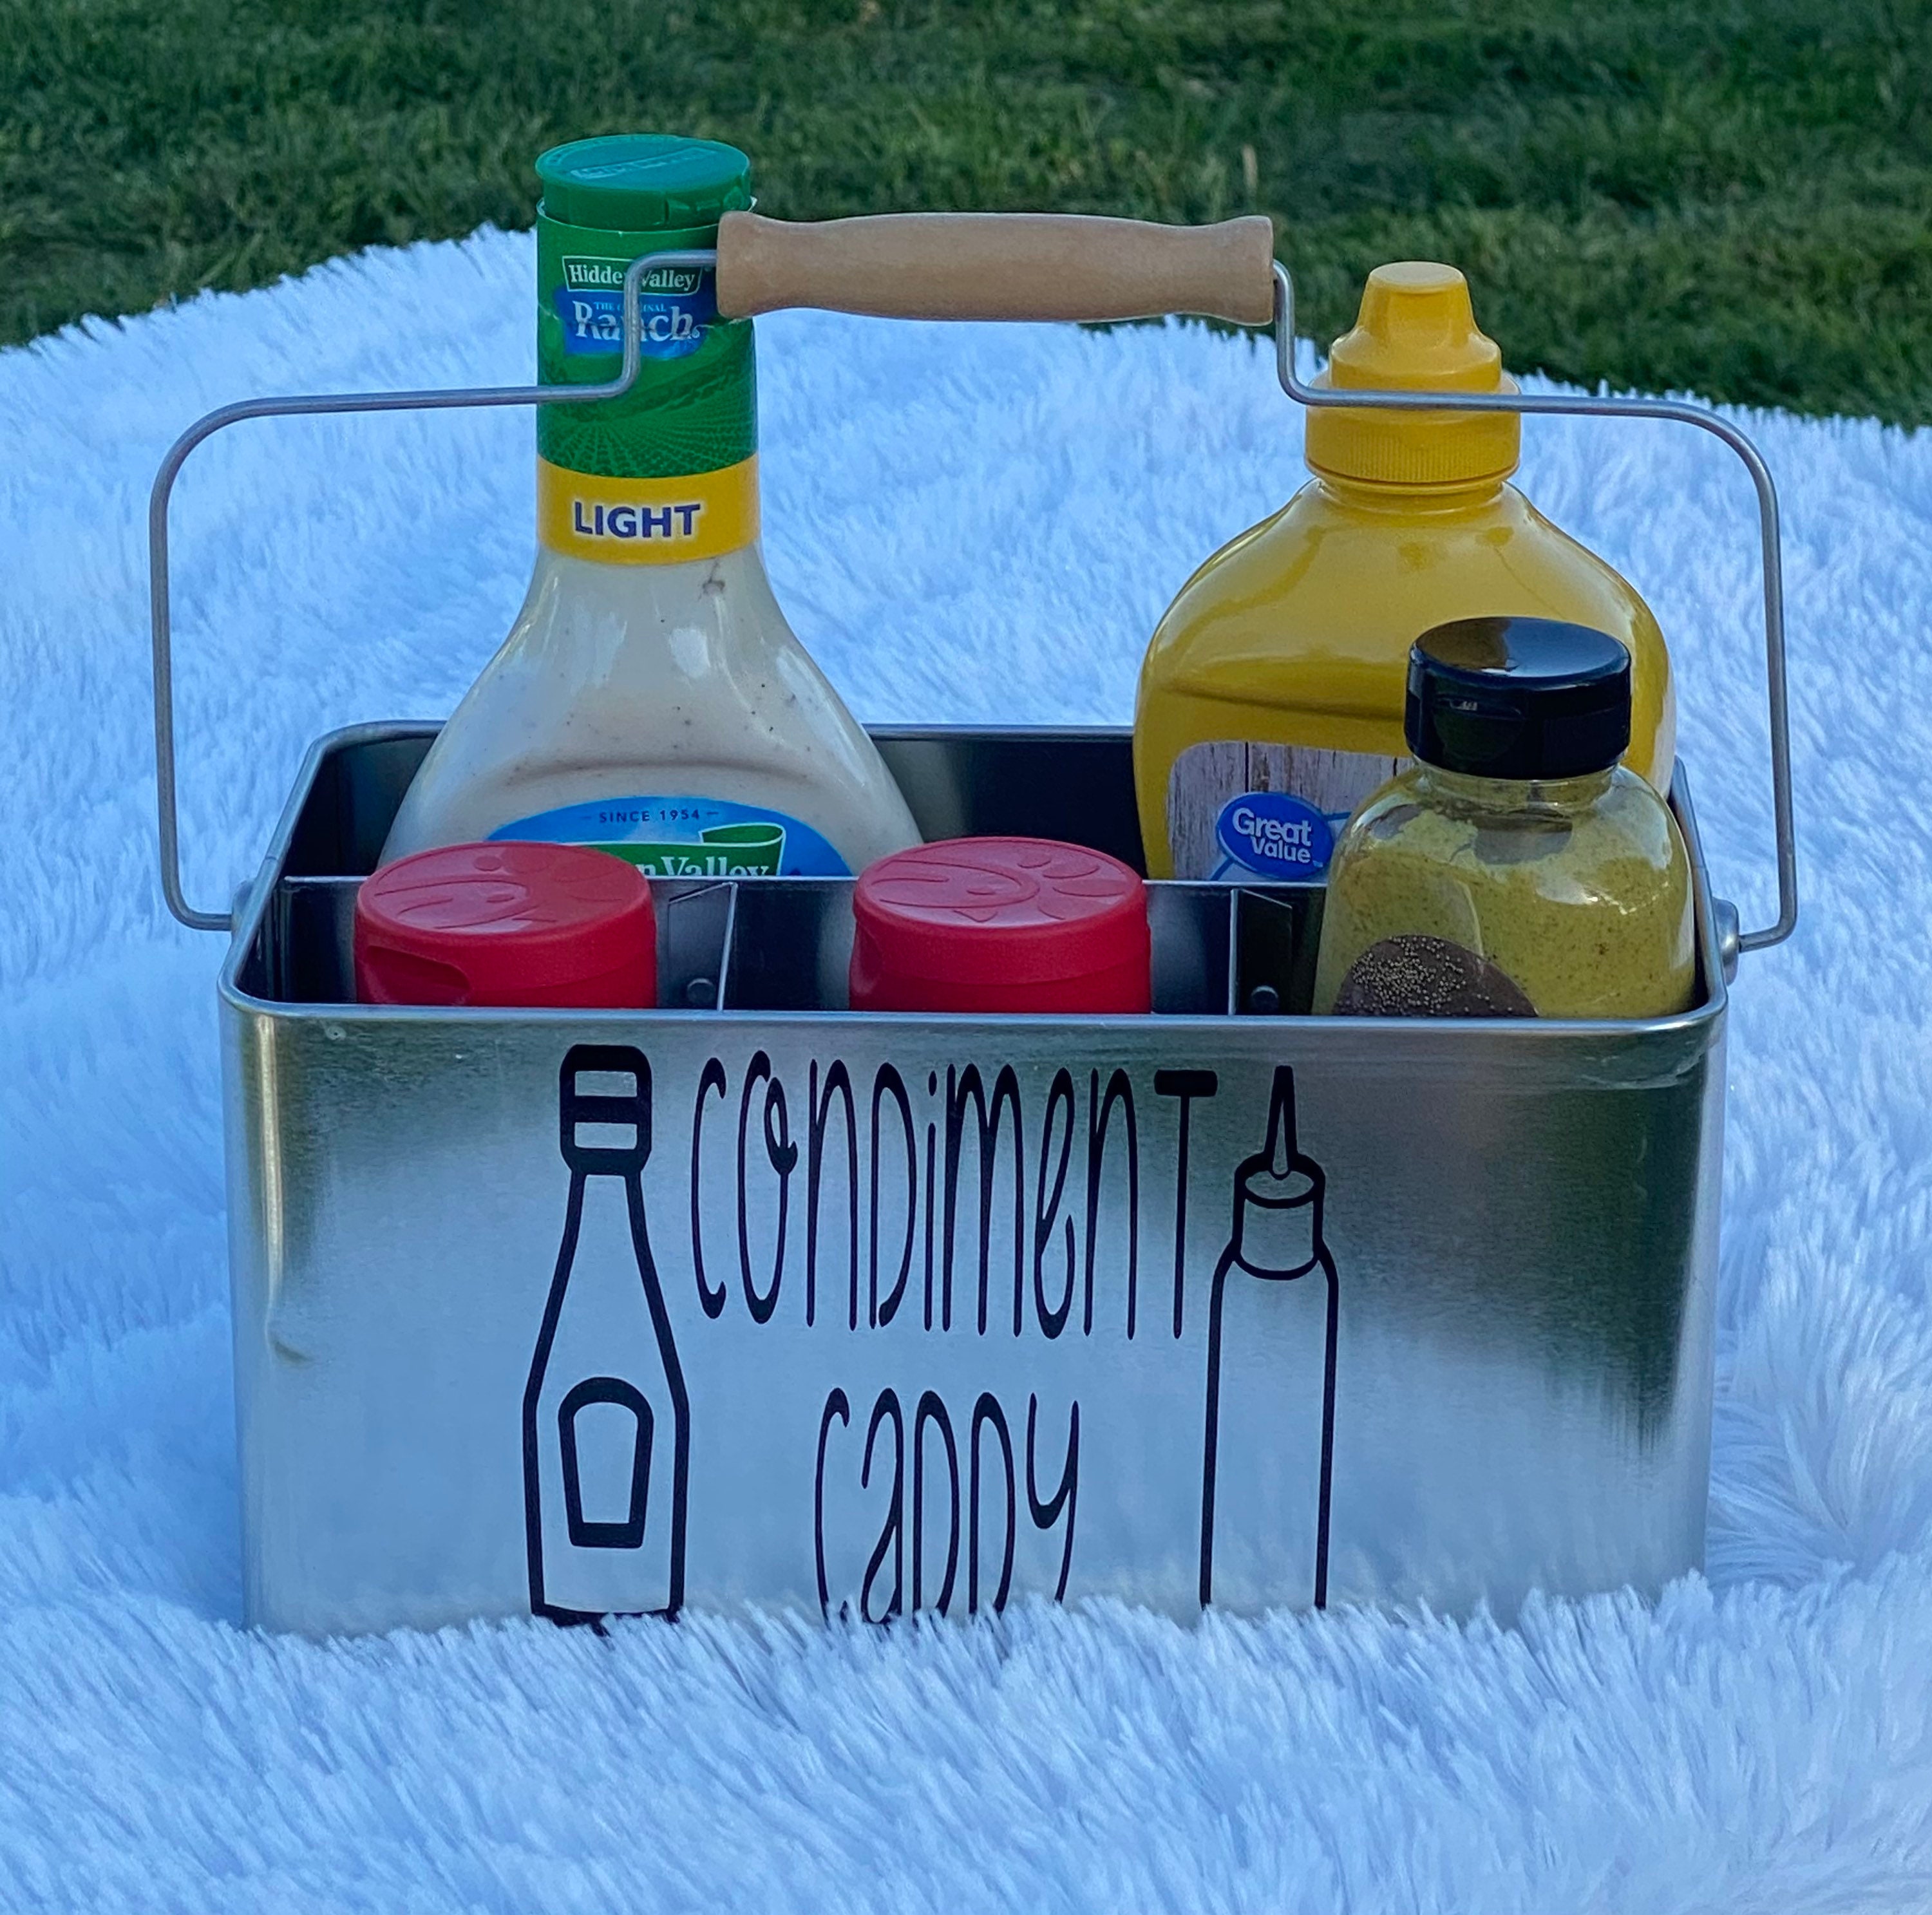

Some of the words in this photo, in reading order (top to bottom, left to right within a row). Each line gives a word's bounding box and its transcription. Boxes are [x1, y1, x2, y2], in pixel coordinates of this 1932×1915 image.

[568, 264, 625, 284] Hidde
[594, 301, 615, 311] THE
[572, 300, 694, 343] Rach
[574, 501, 701, 538] LIGHT
[599, 810, 650, 823] SINCE
[659, 809, 700, 821] 1954
[1232, 807, 1312, 847] Great
[1250, 836, 1311, 863] Value
